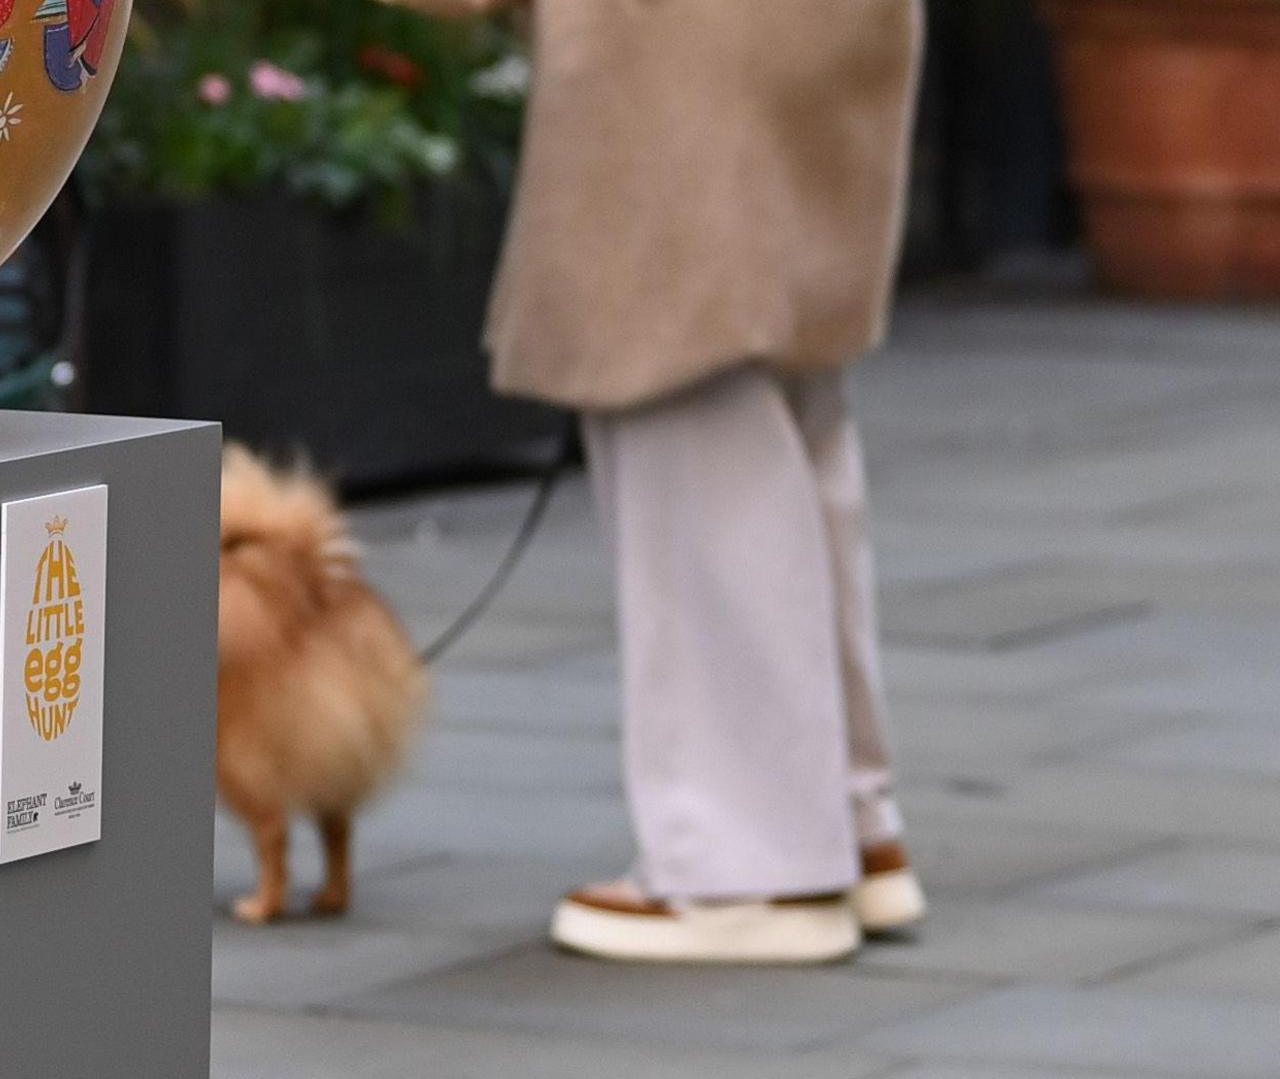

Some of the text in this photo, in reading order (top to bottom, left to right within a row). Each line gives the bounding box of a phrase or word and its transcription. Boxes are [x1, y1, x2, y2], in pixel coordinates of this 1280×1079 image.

[33, 540, 81, 604] THE
[26, 600, 84, 645] LITTLE
[24, 638, 82, 702] egg
[26, 692, 80, 741] HUNT
[7, 793, 47, 814] ELEPHANT
